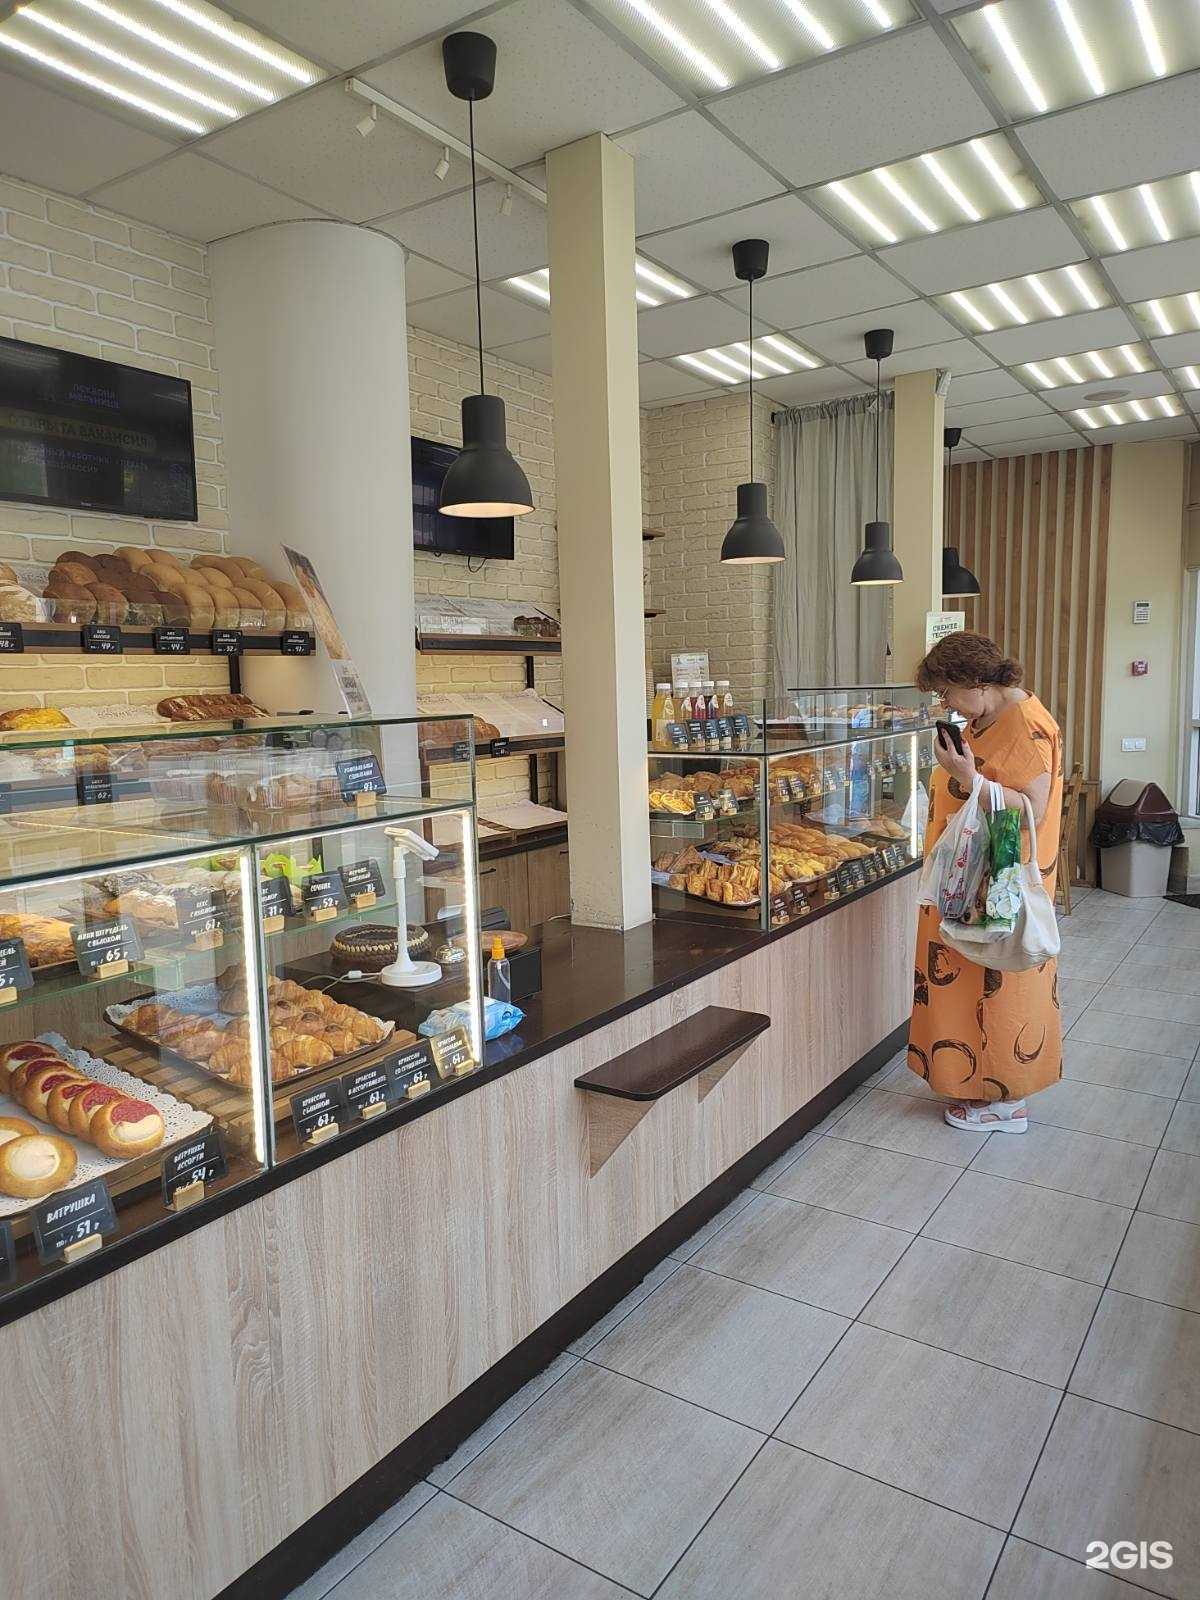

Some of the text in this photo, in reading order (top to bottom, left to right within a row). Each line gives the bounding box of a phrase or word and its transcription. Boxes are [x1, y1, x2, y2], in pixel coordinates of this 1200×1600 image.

[106, 948, 121, 961] 65
[174, 1142, 205, 1163] ВАТРУШКА
[177, 1152, 205, 1171] АССОРТИ
[192, 1167, 207, 1183] 54
[46, 1193, 96, 1223] ВАТРУШКА
[77, 1219, 91, 1238] 51
